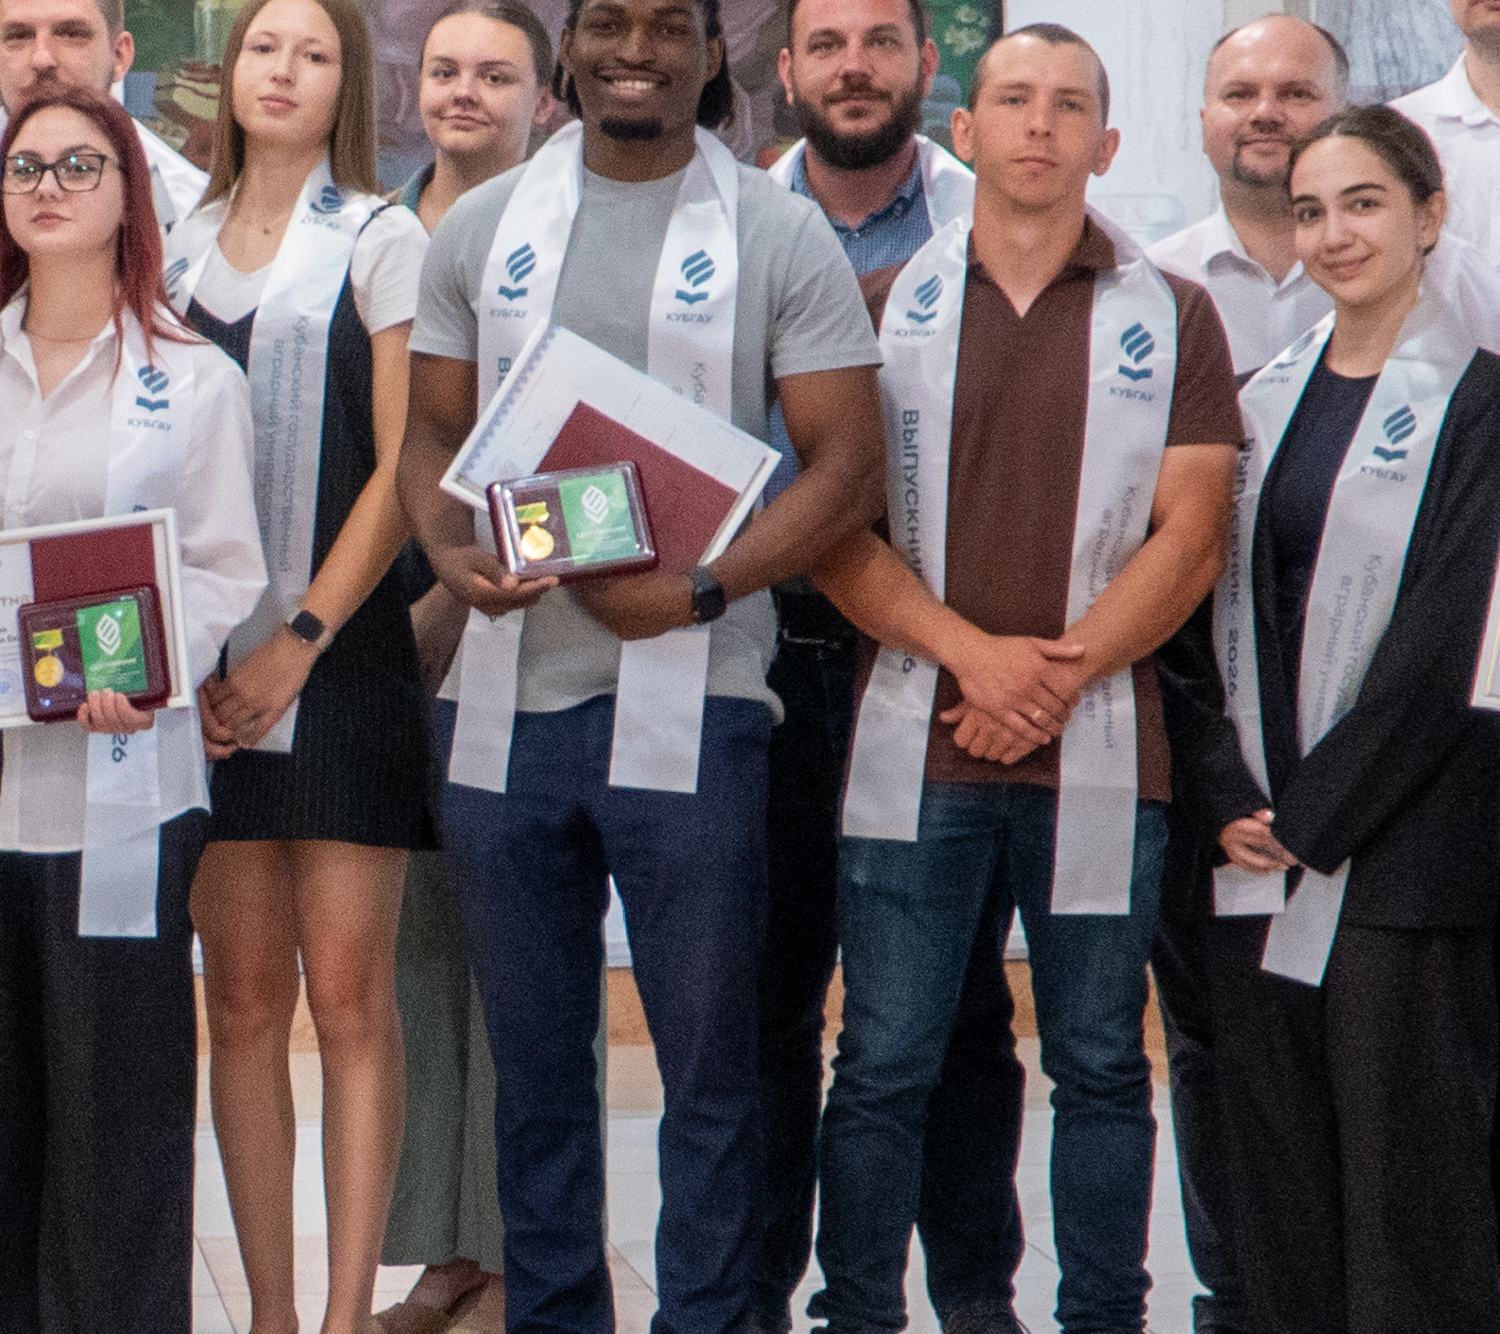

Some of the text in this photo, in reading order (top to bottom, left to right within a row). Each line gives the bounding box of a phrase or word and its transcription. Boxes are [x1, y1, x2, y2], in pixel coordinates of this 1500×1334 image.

[666, 312, 714, 324] КУБГАУ
[1109, 386, 1155, 402] КУБГАУ
[127, 418, 172, 431] КУБГАУ
[1227, 629, 1238, 697] 2026
